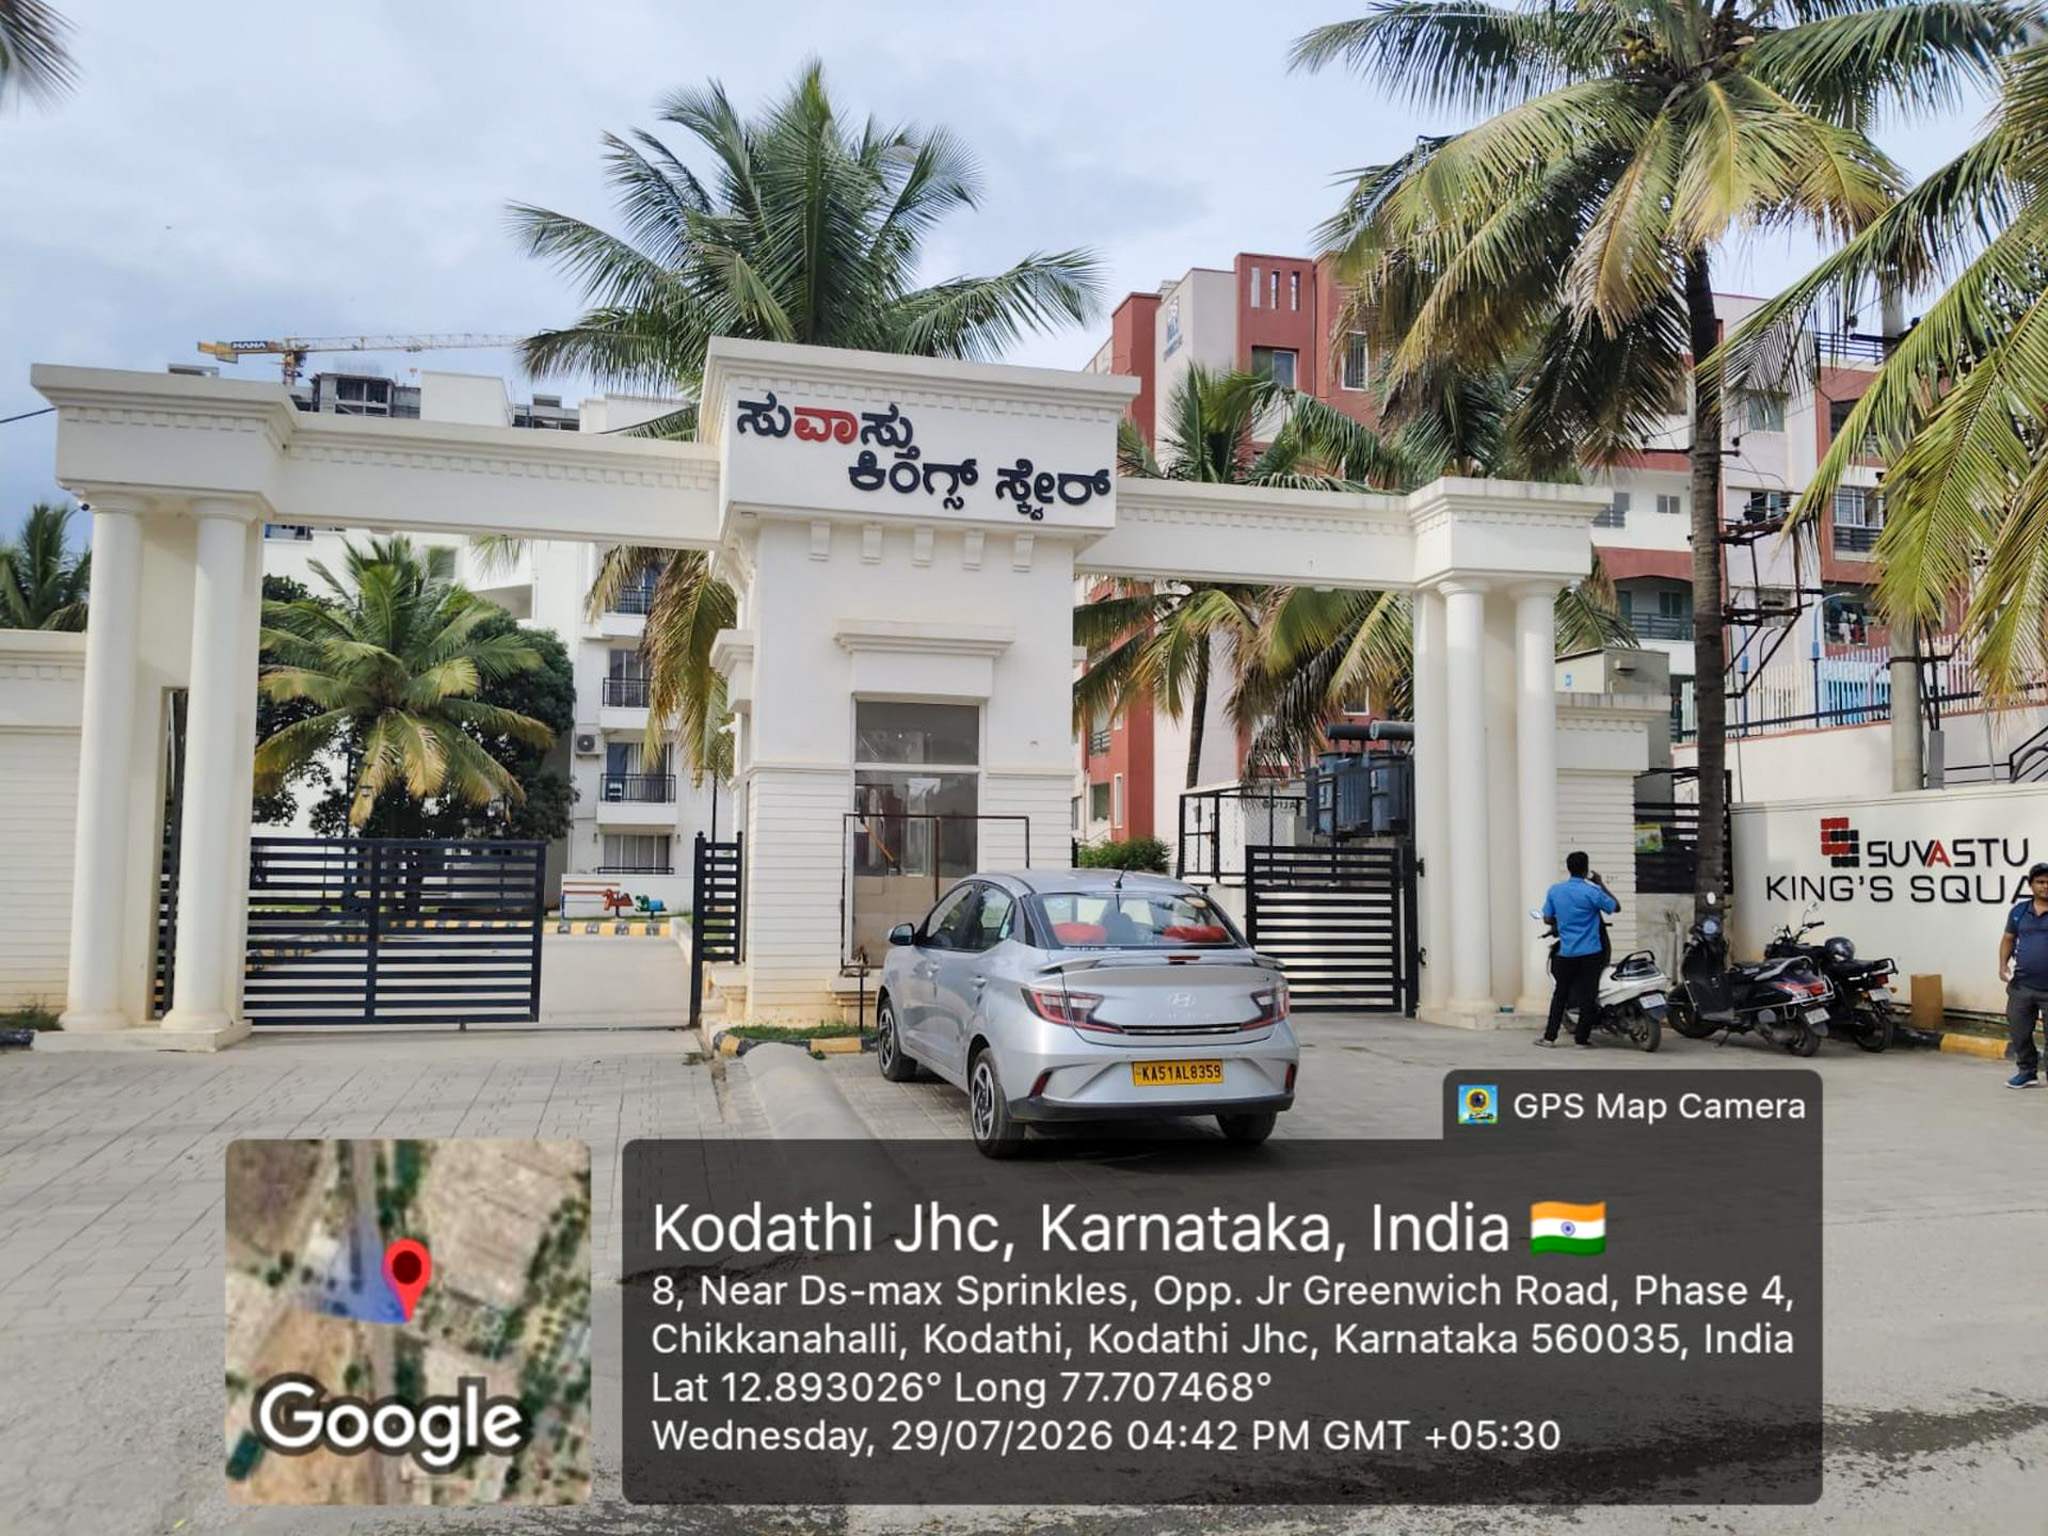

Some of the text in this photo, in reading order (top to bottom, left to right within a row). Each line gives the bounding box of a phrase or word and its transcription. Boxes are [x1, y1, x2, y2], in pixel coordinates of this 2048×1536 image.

[737, 391, 921, 461] ಸುವಾಸ್ತು
[848, 450, 1111, 521] ಕಿಂಗ್ಸ್ ಸ್ಕ್ವೇರ್
[1867, 837, 2029, 868] SUVASTU
[1766, 874, 1894, 903] KING'S
[1142, 1064, 1221, 1081] KA51AL8359
